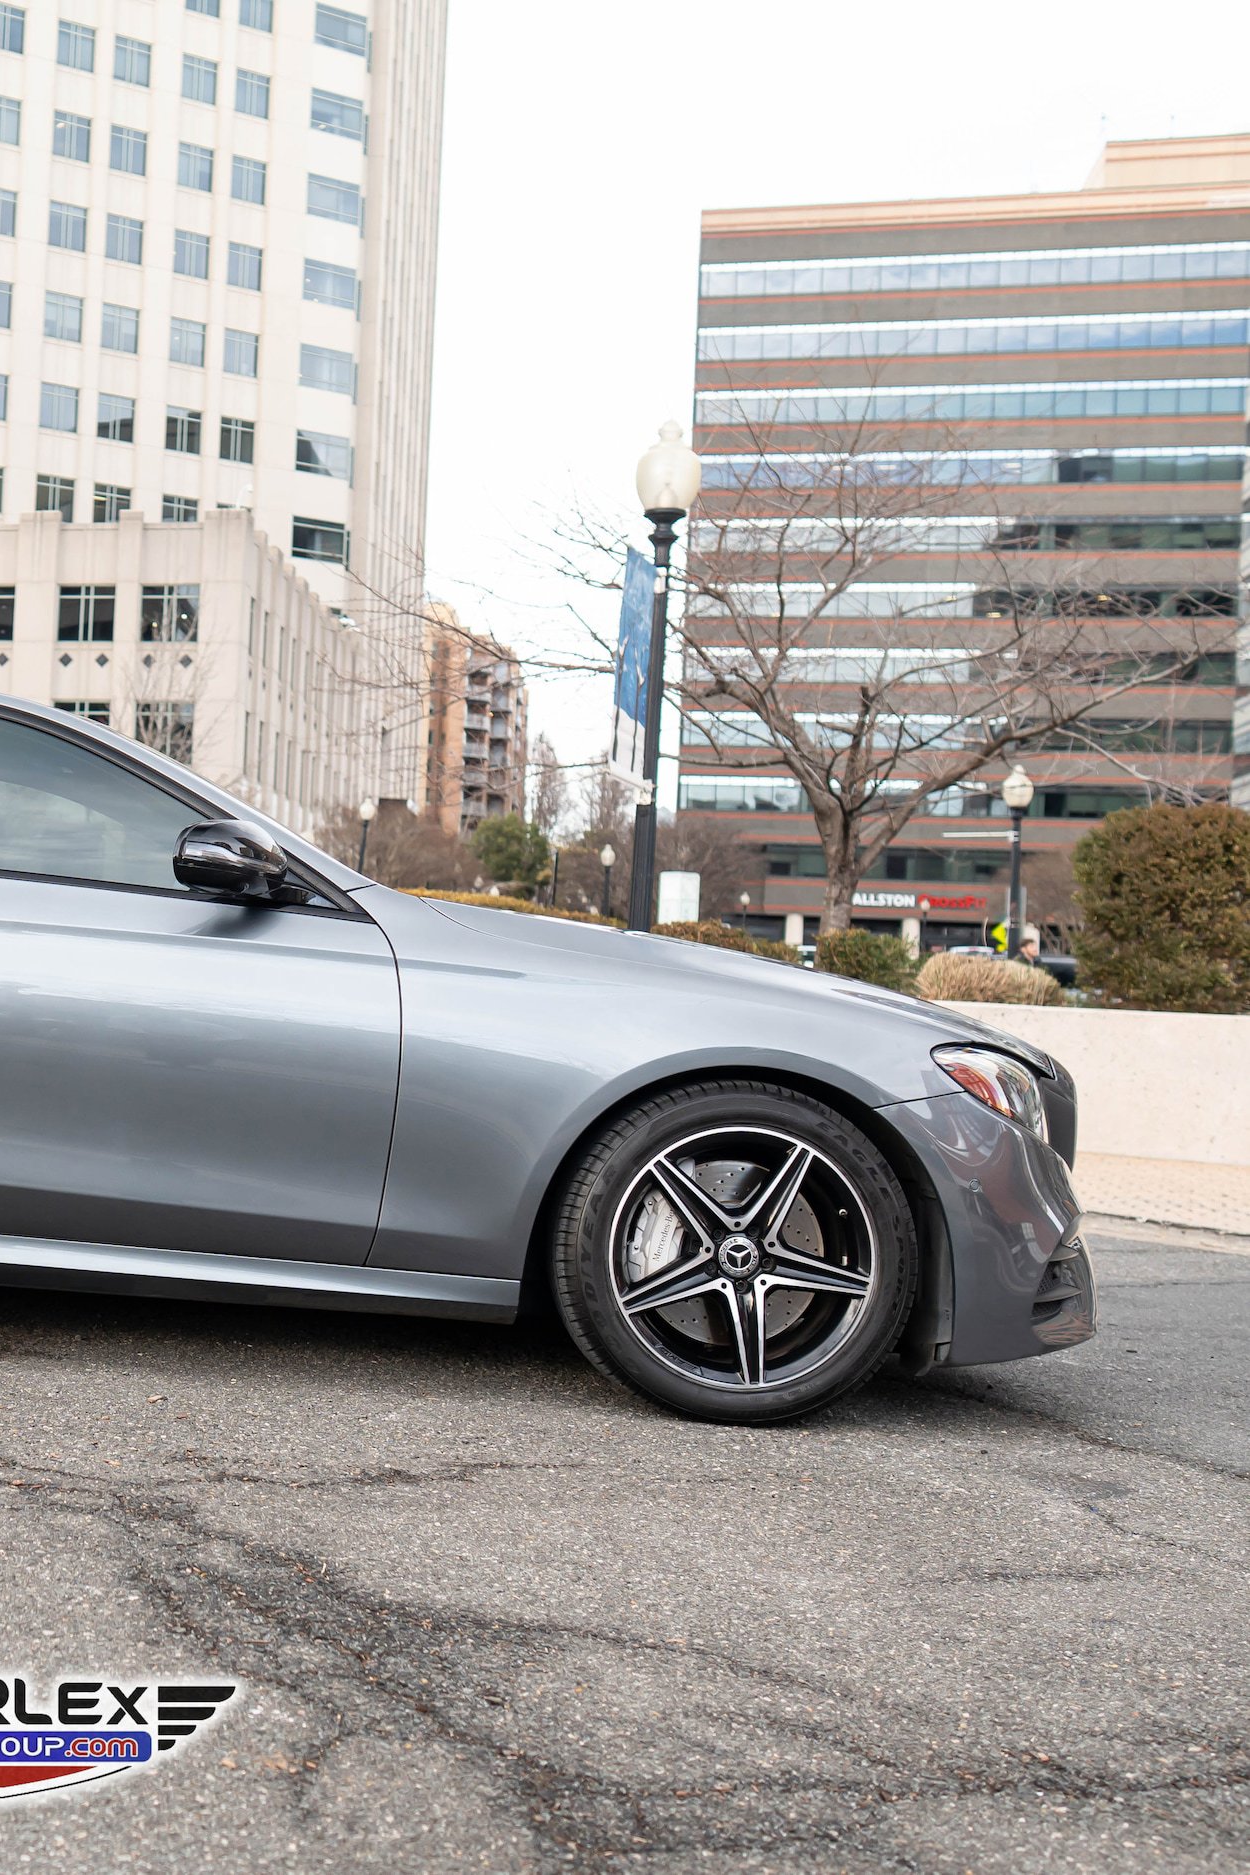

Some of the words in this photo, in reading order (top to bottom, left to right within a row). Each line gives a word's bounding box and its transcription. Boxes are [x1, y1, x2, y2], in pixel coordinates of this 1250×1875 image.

[852, 892, 916, 908] ALLSTON
[815, 1120, 892, 1201] EAGLE
[652, 1209, 675, 1262] Mercedes-Be
